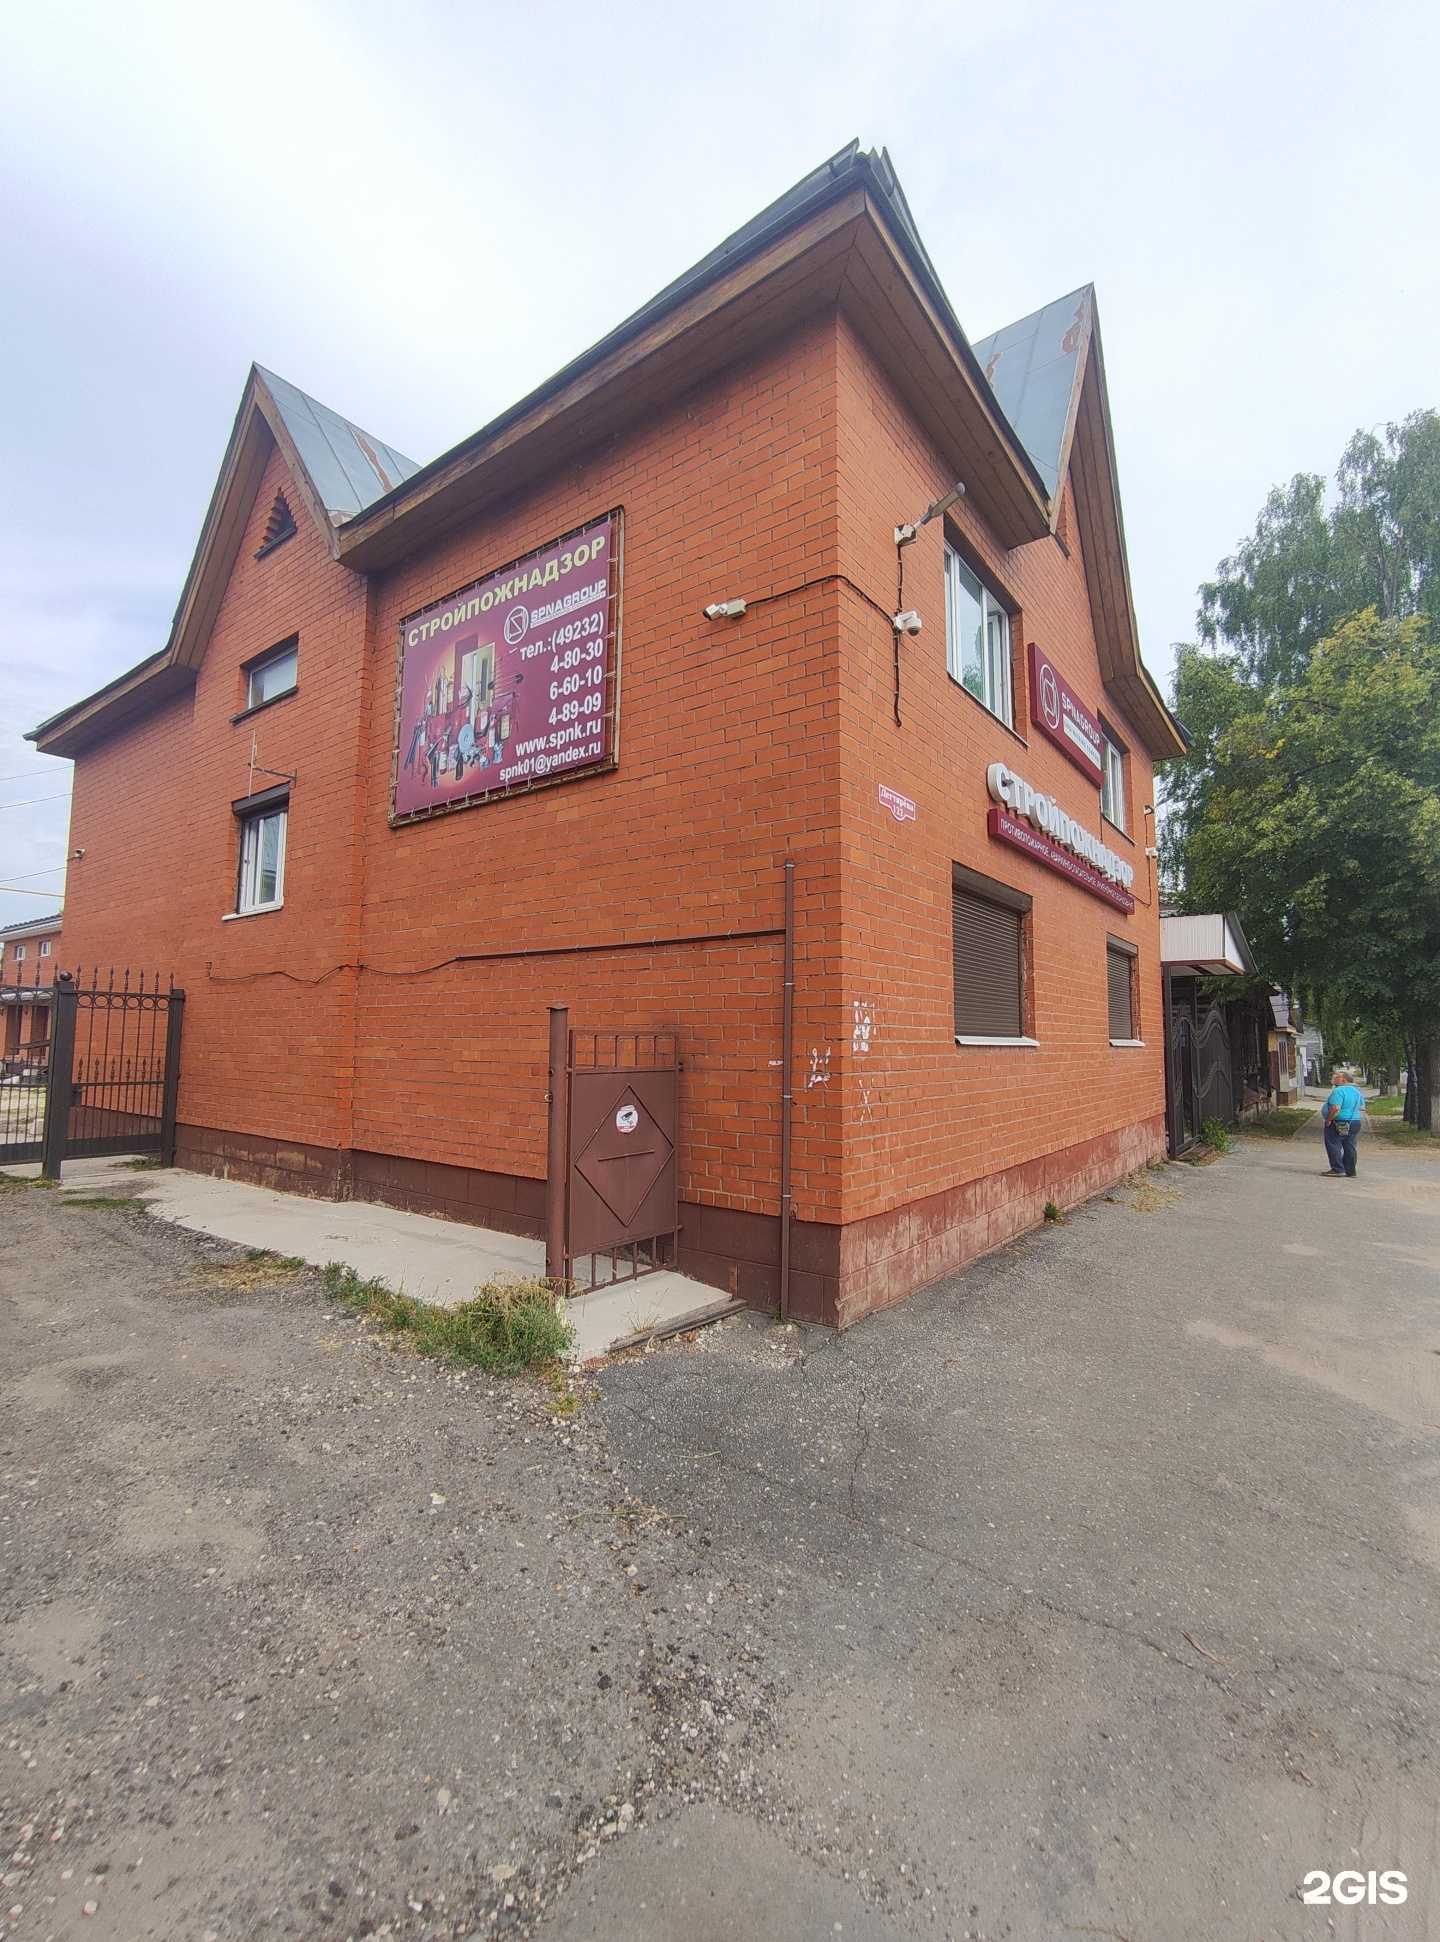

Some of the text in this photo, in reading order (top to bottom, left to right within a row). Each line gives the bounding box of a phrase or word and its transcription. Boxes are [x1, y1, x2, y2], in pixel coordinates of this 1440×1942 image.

[407, 535, 606, 648] СТРОЙПОЖНАДЗОР
[550, 638, 603, 673] 4-80-30
[549, 665, 602, 700] 6-60-10
[548, 692, 602, 725] 4-89-09
[515, 718, 602, 757] www.spnk.ru
[499, 741, 601, 782] spnk01@yandex.ru
